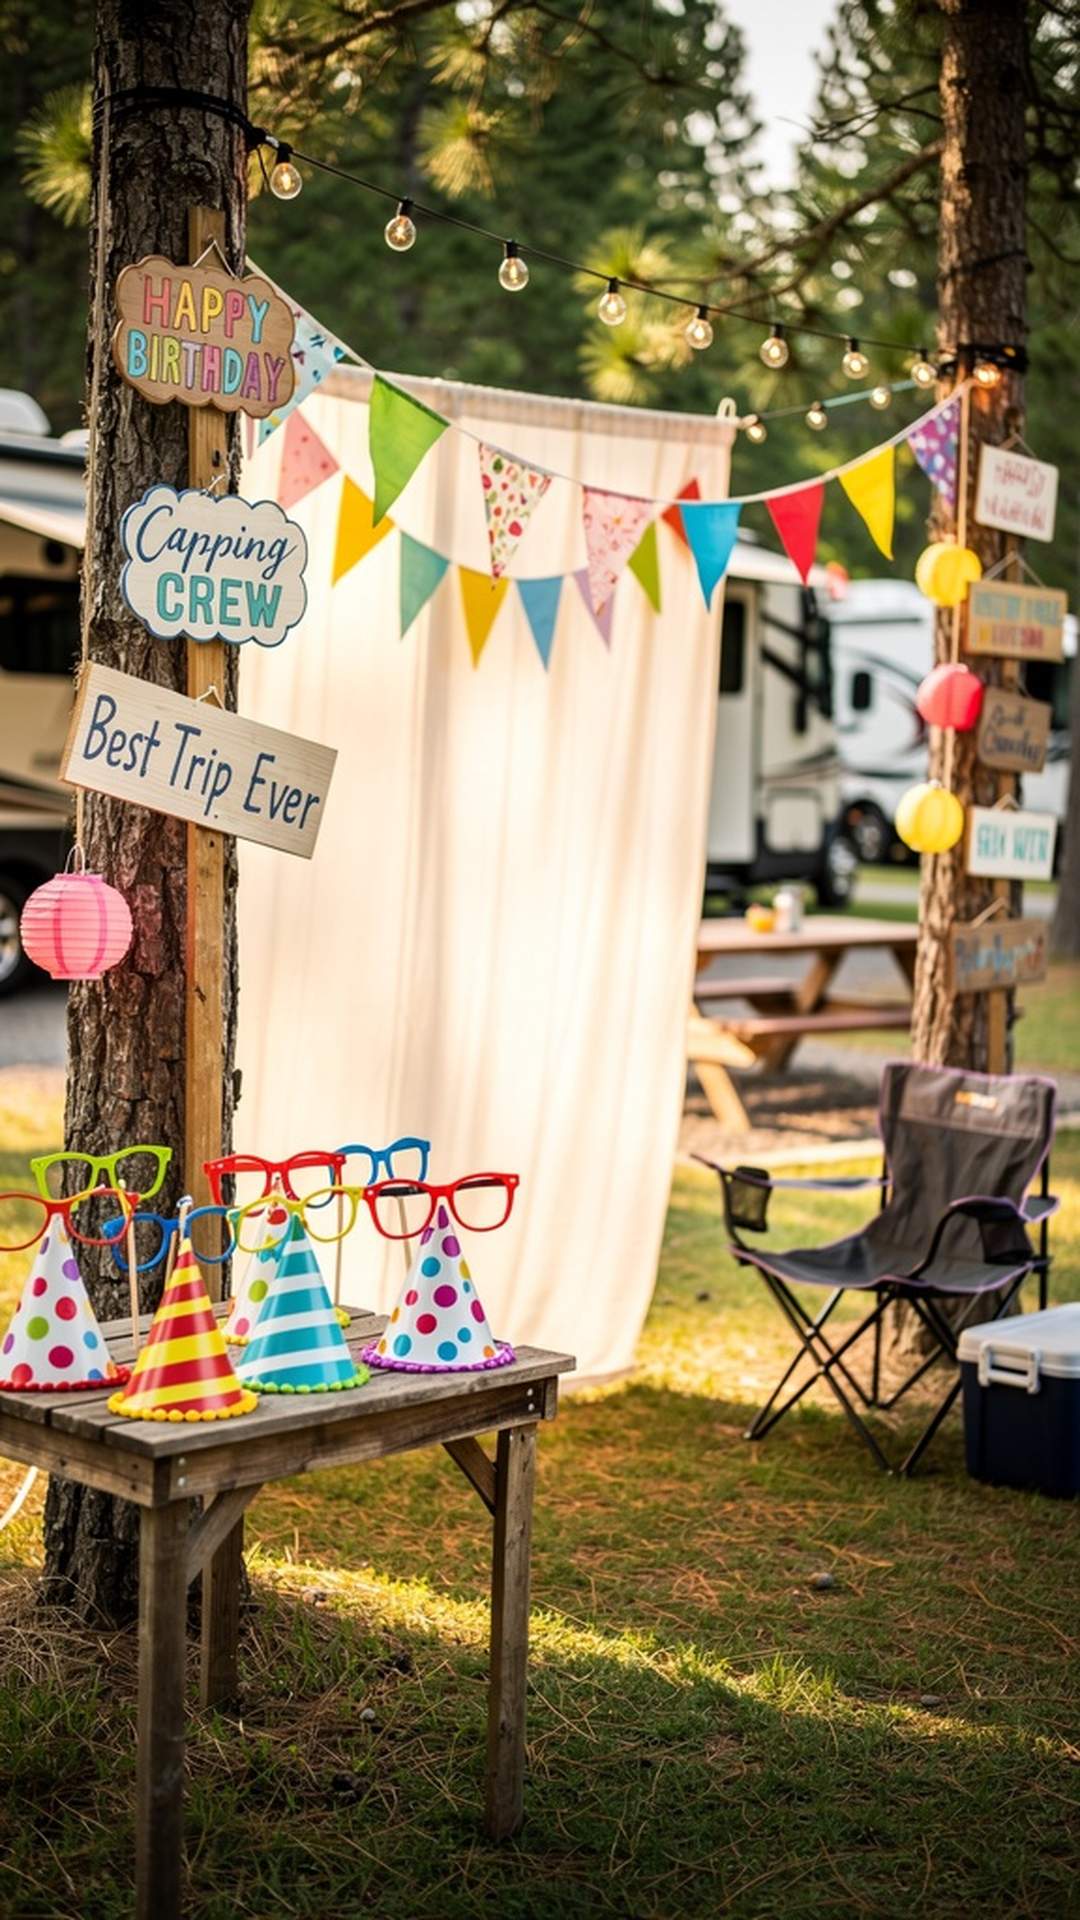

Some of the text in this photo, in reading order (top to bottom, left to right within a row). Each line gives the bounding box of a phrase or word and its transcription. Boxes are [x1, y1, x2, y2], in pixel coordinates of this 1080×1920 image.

[142, 274, 270, 344] HAPPY
[127, 328, 285, 402] BIRTHDAY
[136, 504, 298, 581] Capping
[156, 571, 283, 629] CREW
[82, 694, 321, 830] Best Trip Ever
